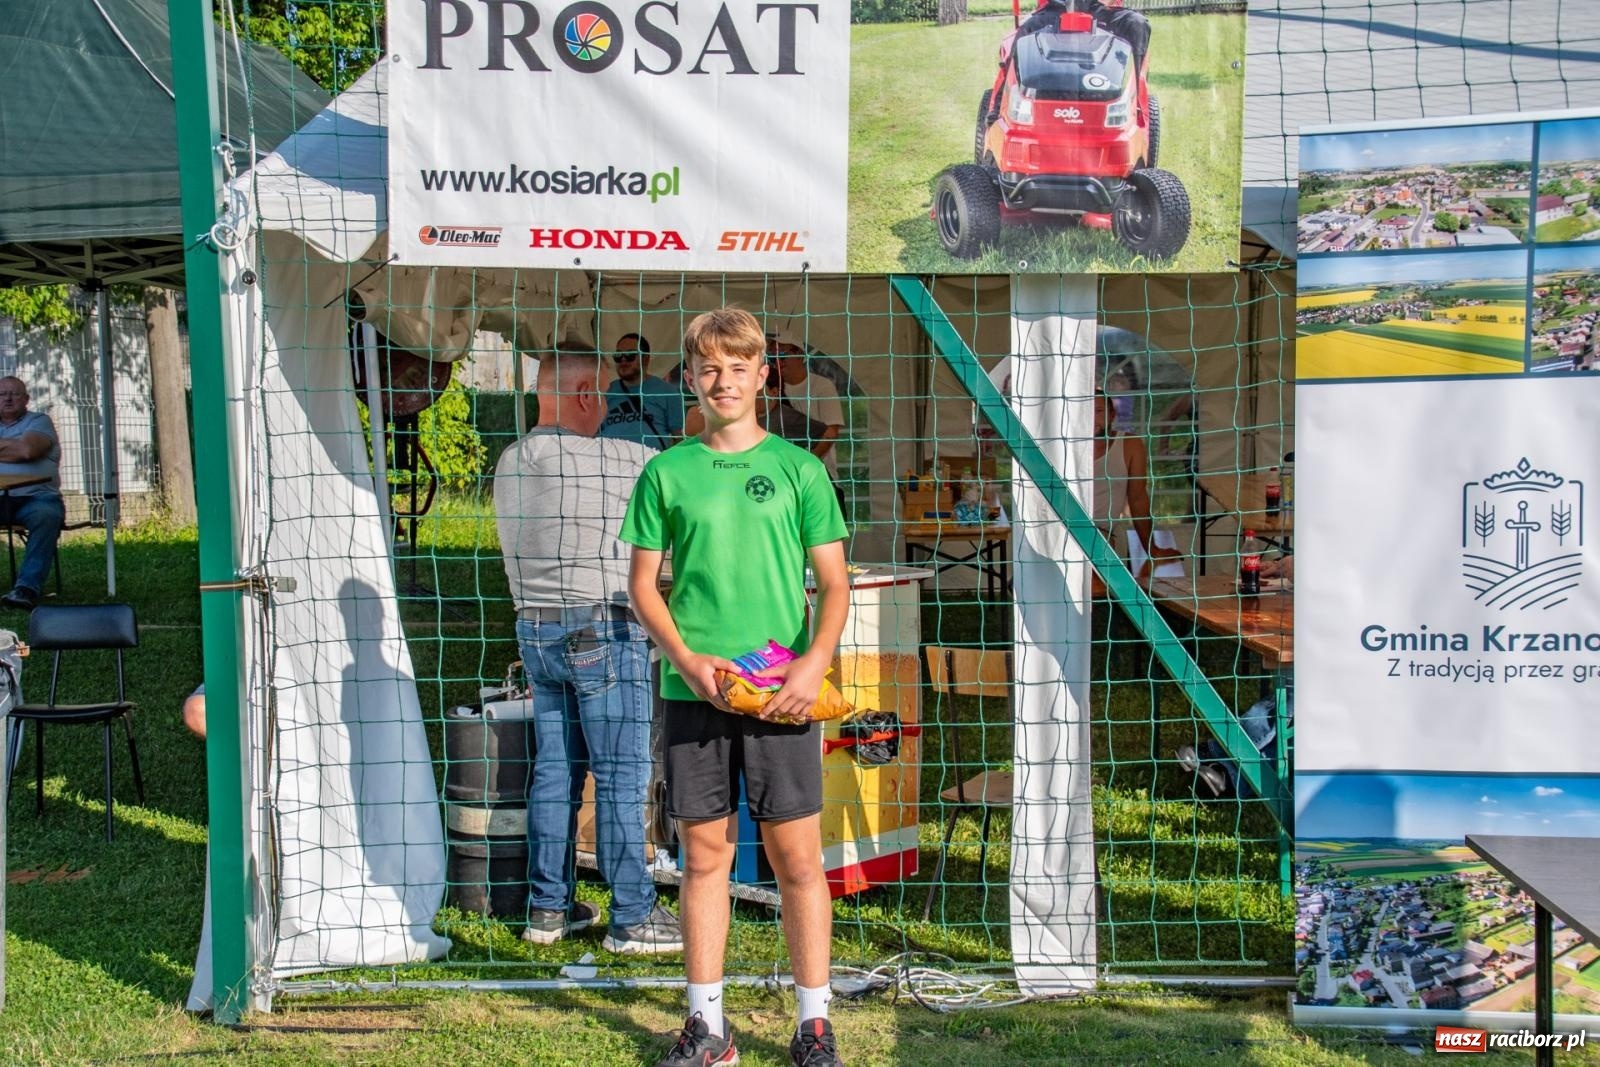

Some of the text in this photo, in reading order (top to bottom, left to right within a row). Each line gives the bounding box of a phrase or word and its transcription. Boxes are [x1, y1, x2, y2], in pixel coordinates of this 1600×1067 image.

[417, 0, 819, 75] PROSAT
[1053, 106, 1080, 119] solo
[420, 164, 680, 203] www.kosiarka.pl
[439, 229, 501, 244] Oleo-Mac
[529, 228, 690, 251] HONDA
[717, 231, 804, 252] STIHL
[1361, 625, 1600, 652] Gmina Krzano
[1388, 659, 1400, 677] Z
[1409, 657, 1495, 683] tradycją
[1504, 664, 1564, 683] przez
